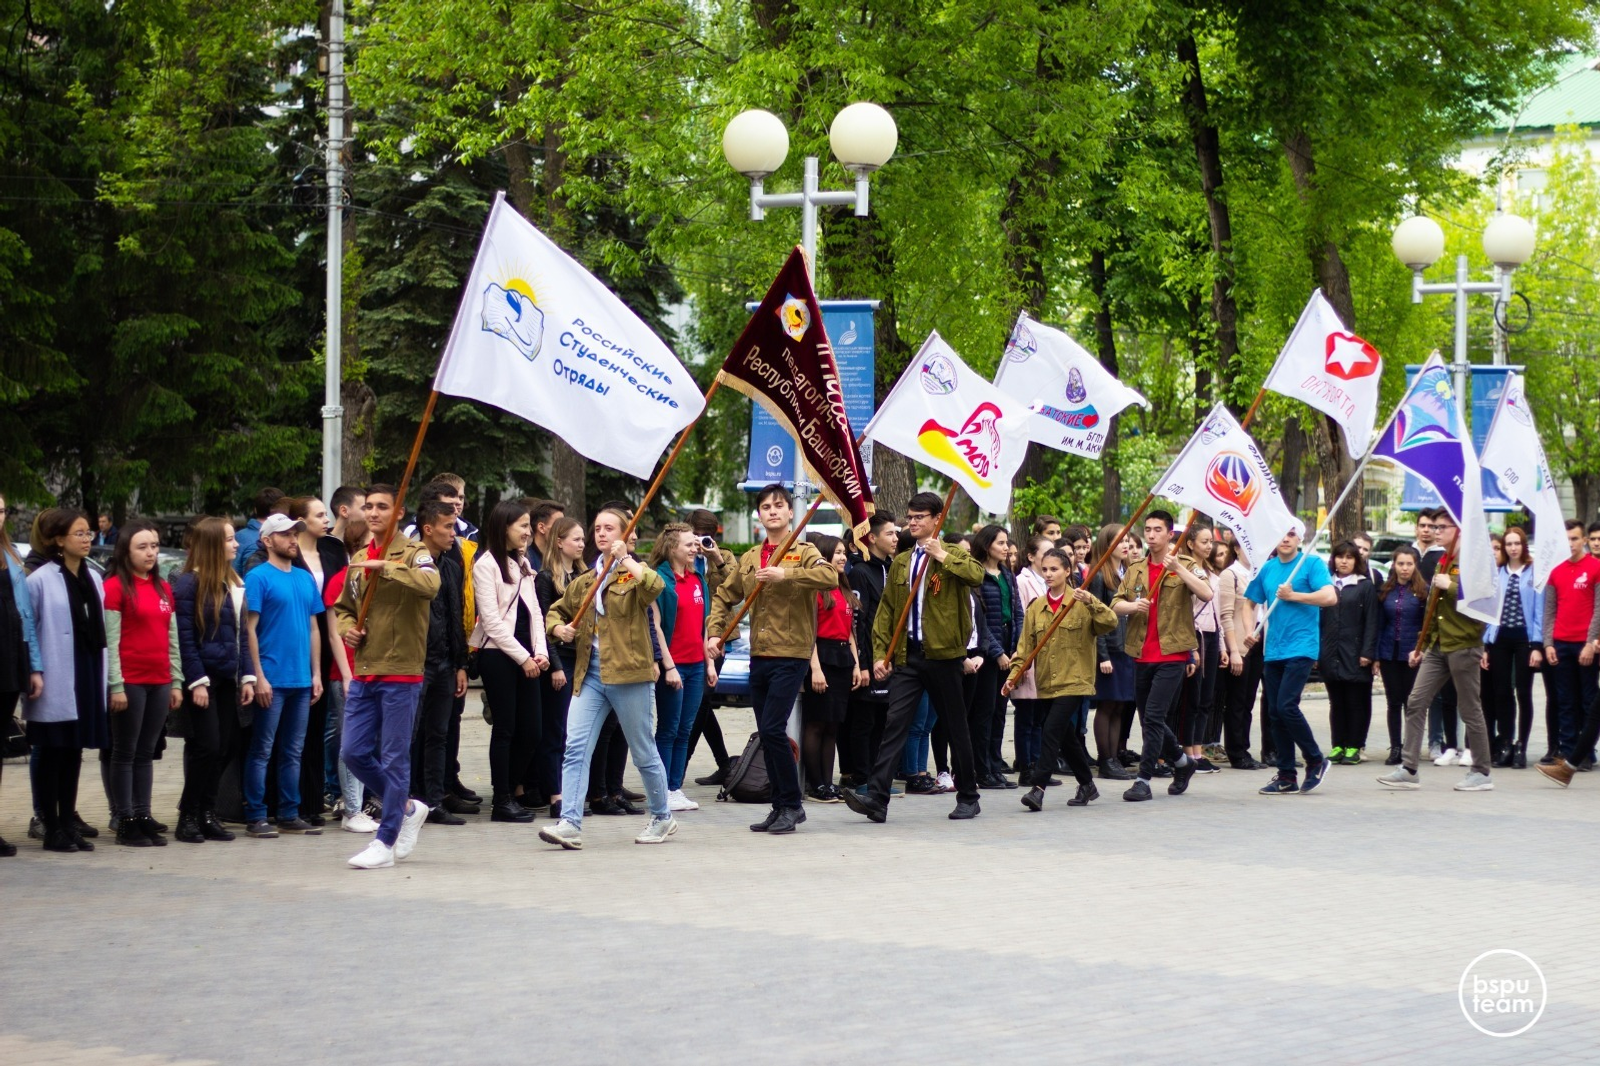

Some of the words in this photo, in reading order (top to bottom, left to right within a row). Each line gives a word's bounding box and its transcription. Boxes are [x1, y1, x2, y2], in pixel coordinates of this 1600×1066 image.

[559, 331, 679, 409] Студенческие
[571, 318, 673, 385] Российские
[553, 358, 611, 396] Отряды
[1167, 483, 1184, 495] СПО
[1503, 467, 1519, 485] СПО
